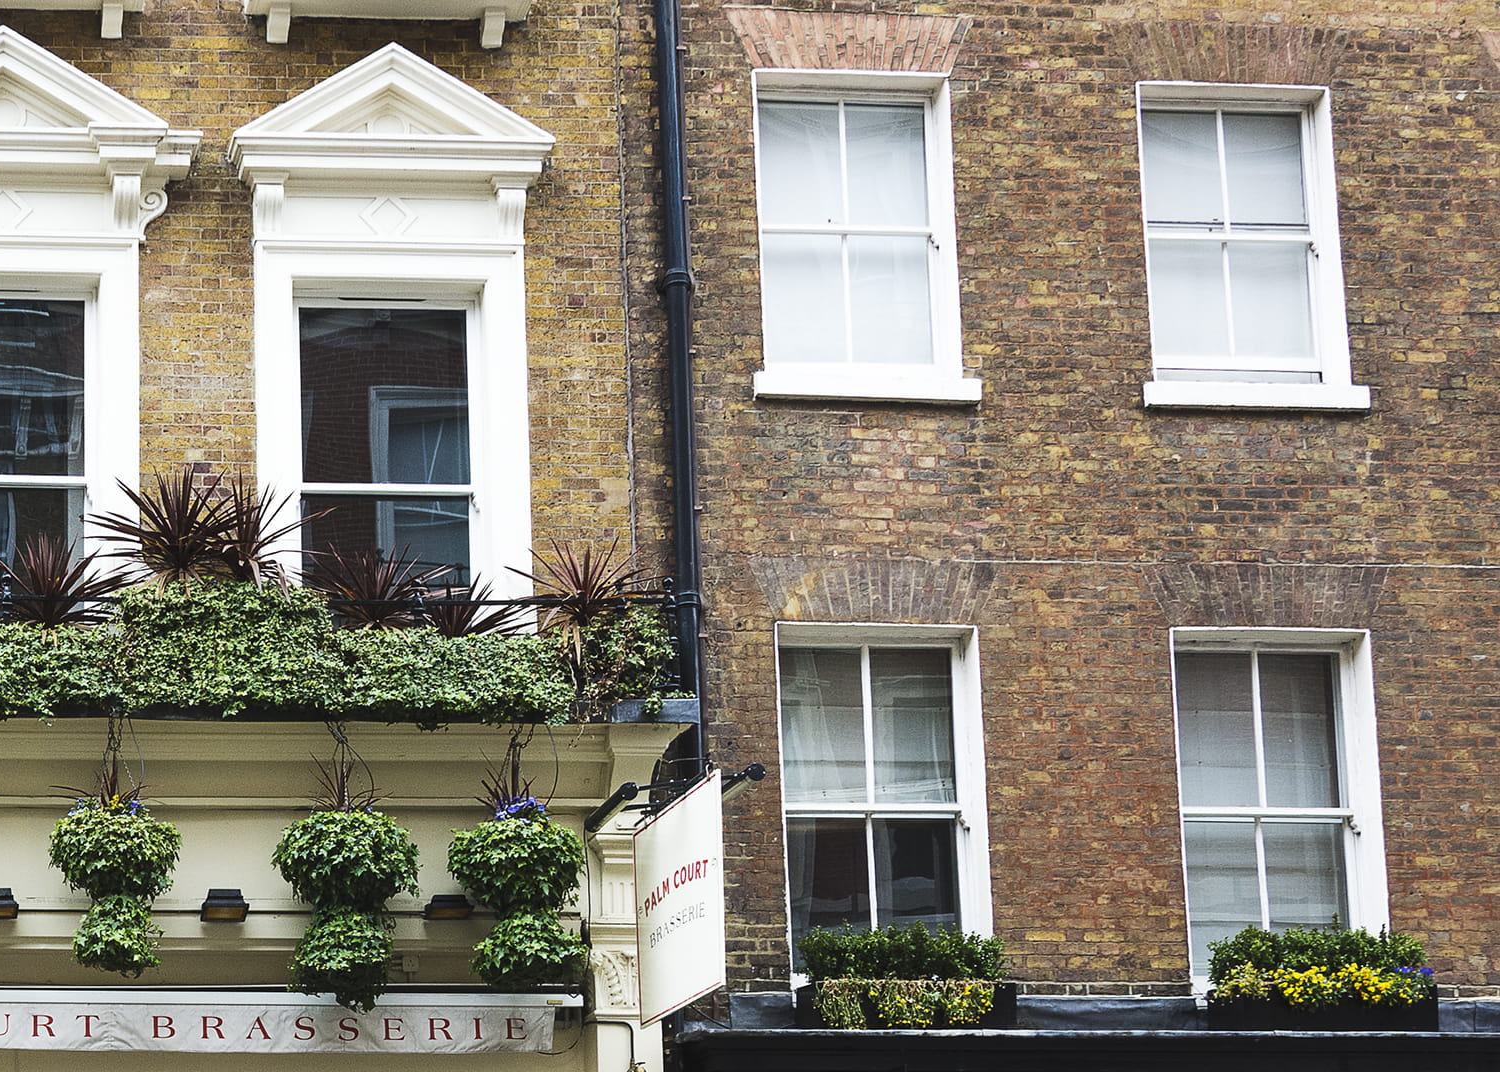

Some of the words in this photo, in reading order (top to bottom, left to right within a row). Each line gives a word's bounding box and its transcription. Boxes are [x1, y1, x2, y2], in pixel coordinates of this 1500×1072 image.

[644, 877, 670, 917] PALM
[673, 859, 708, 888] COURT
[649, 902, 705, 948] BRASSERIE
[151, 1015, 528, 1042] BRASSERIE
